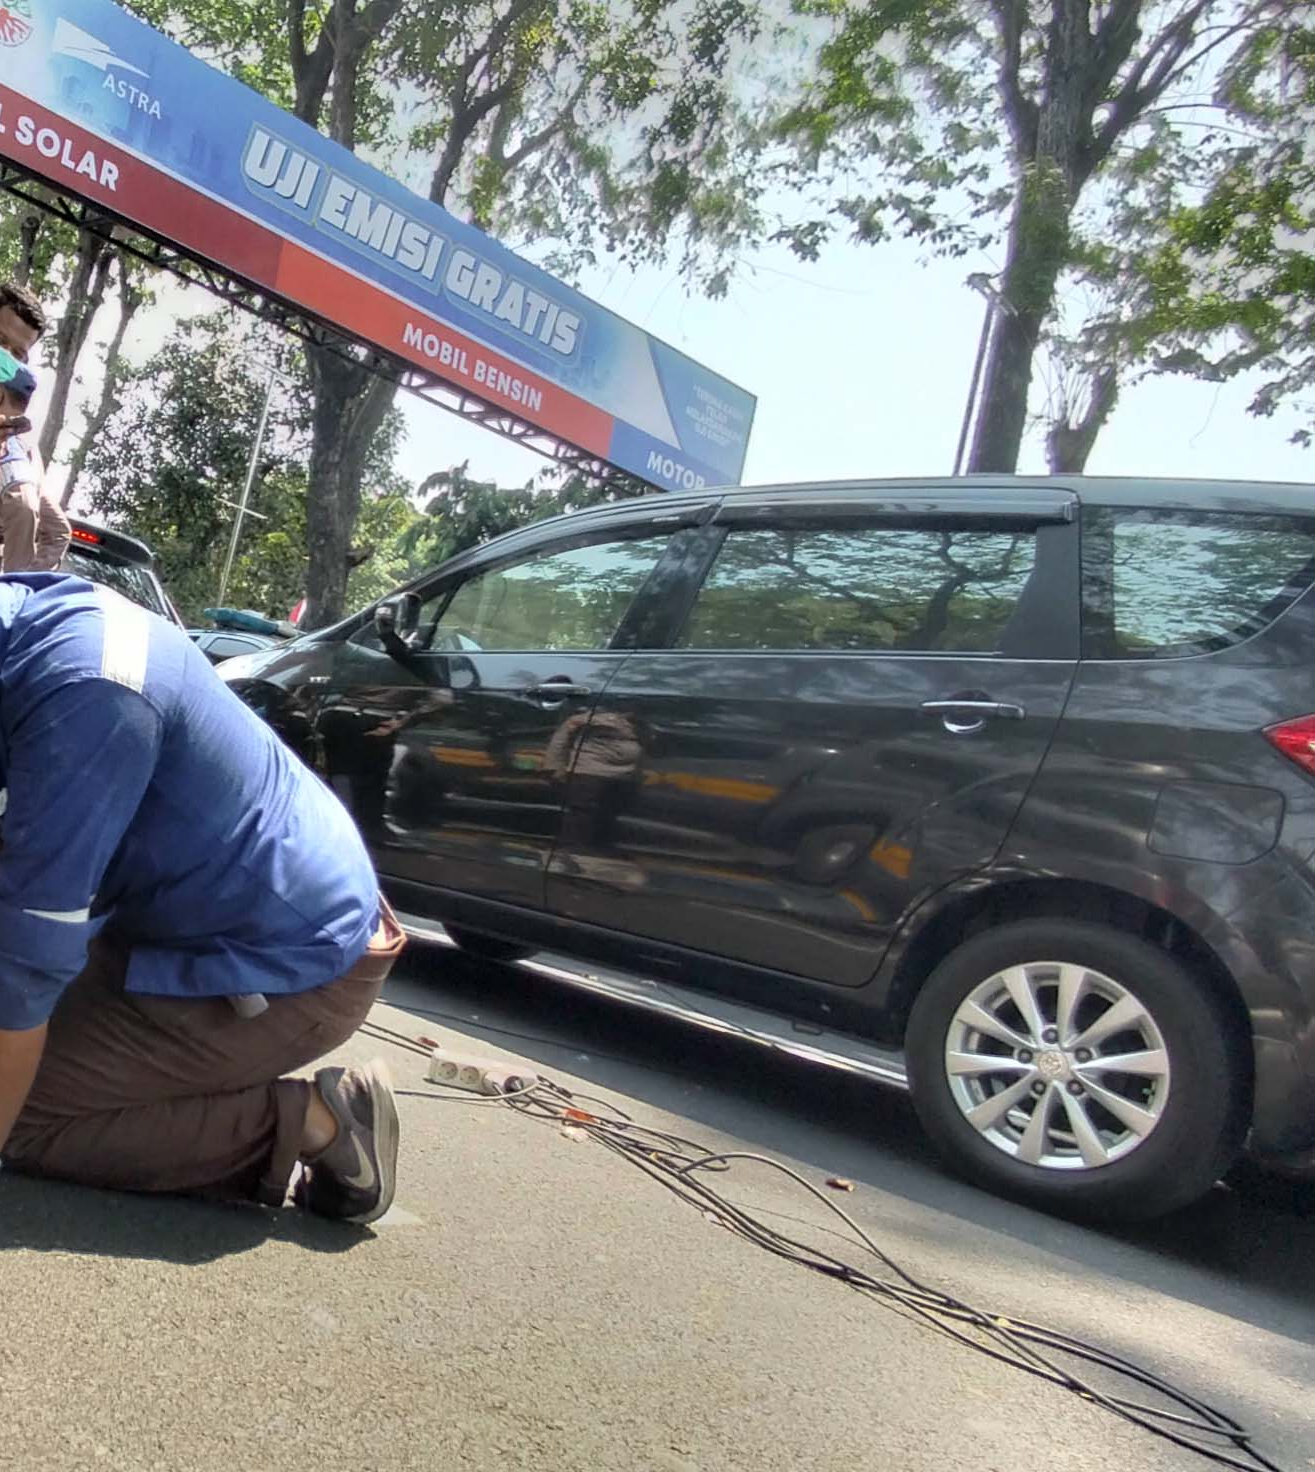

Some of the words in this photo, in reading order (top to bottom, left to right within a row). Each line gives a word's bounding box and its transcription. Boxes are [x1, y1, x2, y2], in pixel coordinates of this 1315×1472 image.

[102, 73, 161, 120] ASTRA
[14, 115, 119, 192] SOLAR
[243, 129, 321, 210] UJI
[319, 174, 445, 281] EMISI
[444, 249, 581, 355] GRATIS
[402, 322, 469, 375] MOBIL
[473, 359, 542, 412] BENSIN
